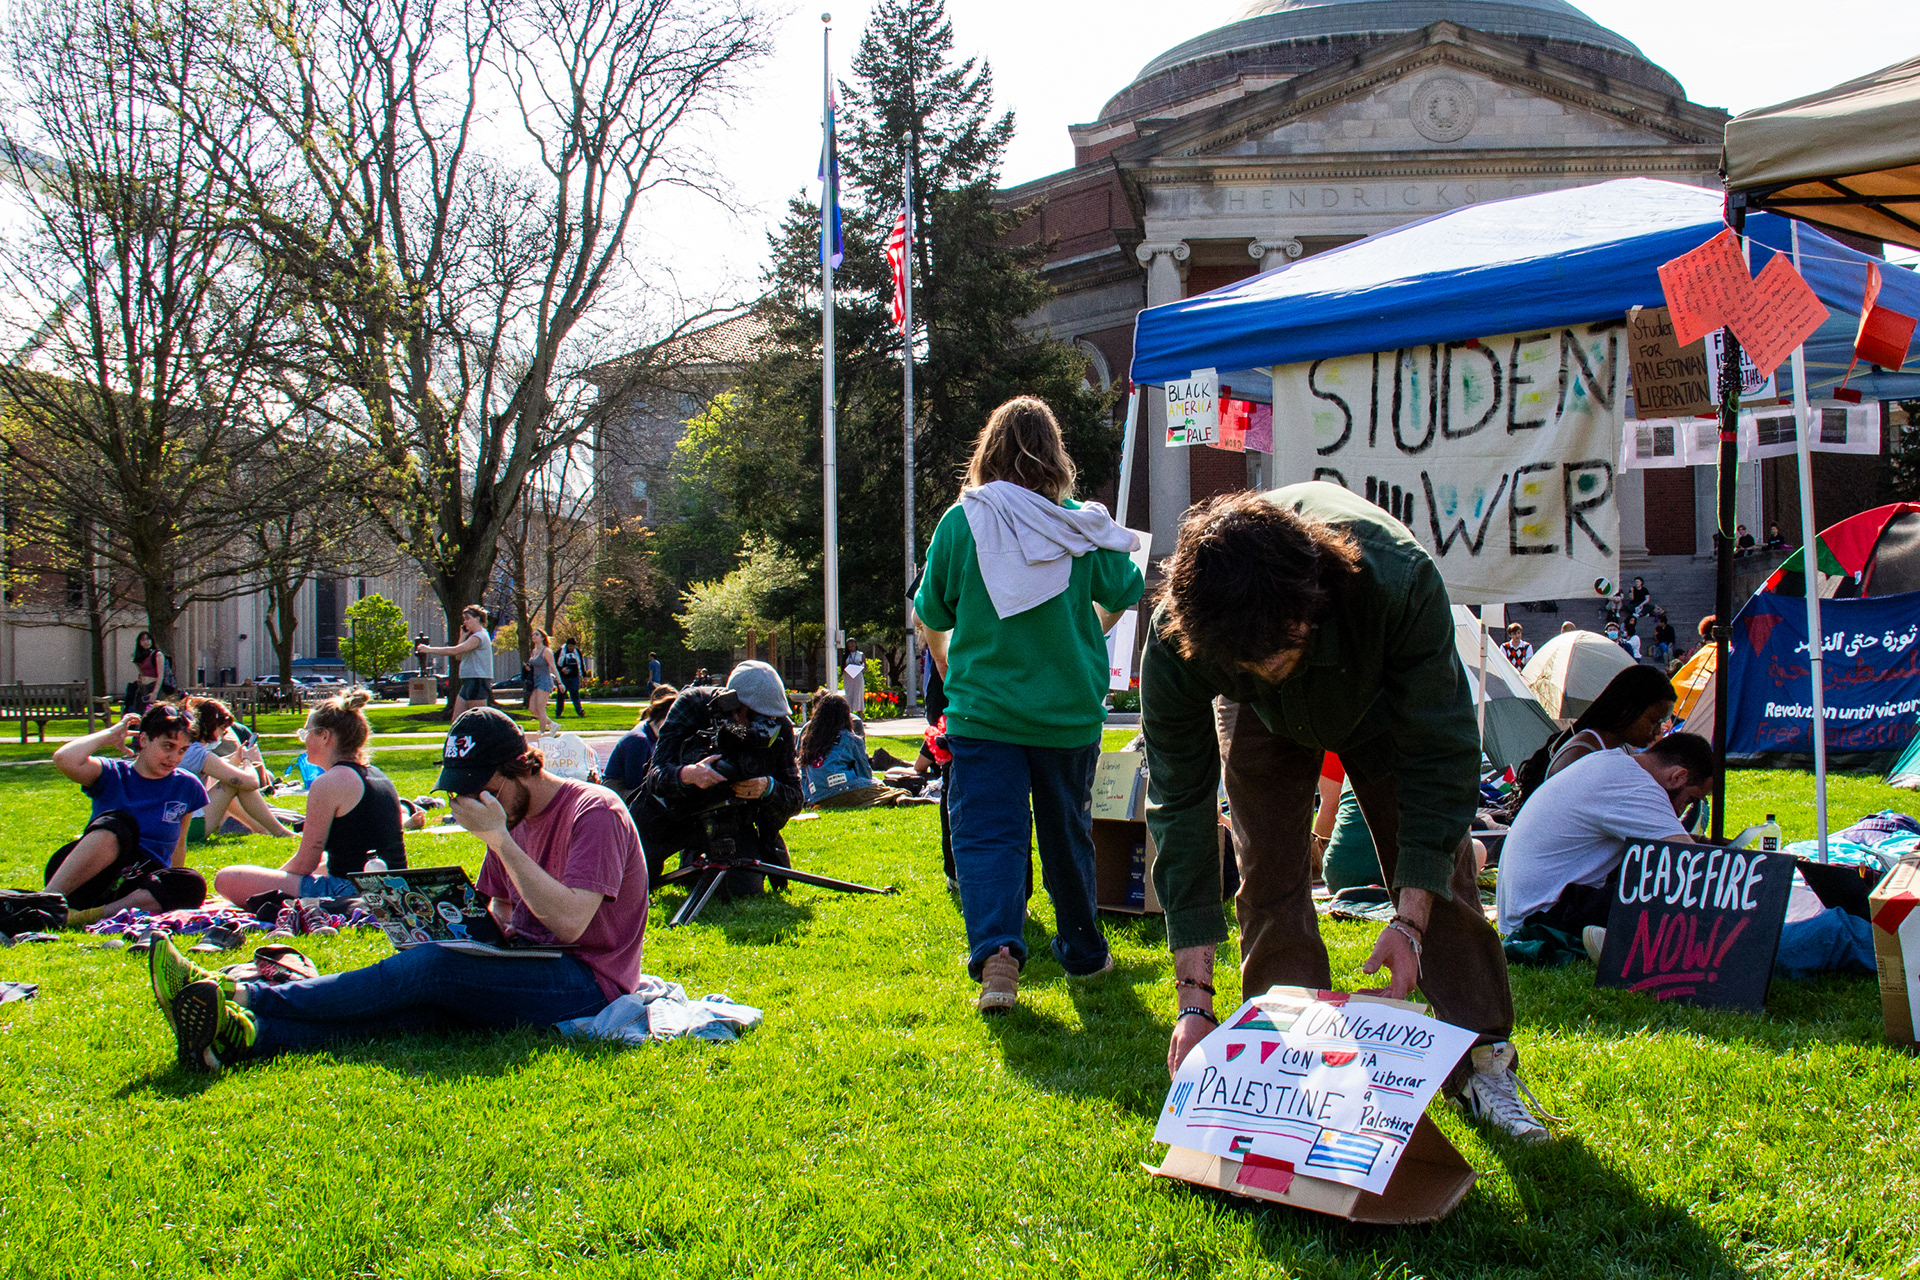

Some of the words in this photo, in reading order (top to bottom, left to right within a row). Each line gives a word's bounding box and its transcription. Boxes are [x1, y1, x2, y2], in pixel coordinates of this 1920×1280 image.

[1228, 184, 1478, 211] HENDRICKS
[1639, 343, 1663, 358] FOR
[1168, 382, 1211, 402] BLACK
[1636, 379, 1711, 408] LIBERATION
[1764, 701, 1838, 720] Revolutn
[1838, 703, 1876, 720] until
[1754, 721, 1801, 745] Free
[1618, 844, 1768, 911] CEASEFIRE
[1620, 910, 1751, 984] NOW!
[1305, 1008, 1436, 1049] URUGAUYOS
[1282, 1047, 1314, 1070] CON
[1197, 1066, 1346, 1120] PALESTINE
[1360, 1105, 1414, 1136] Palestine
